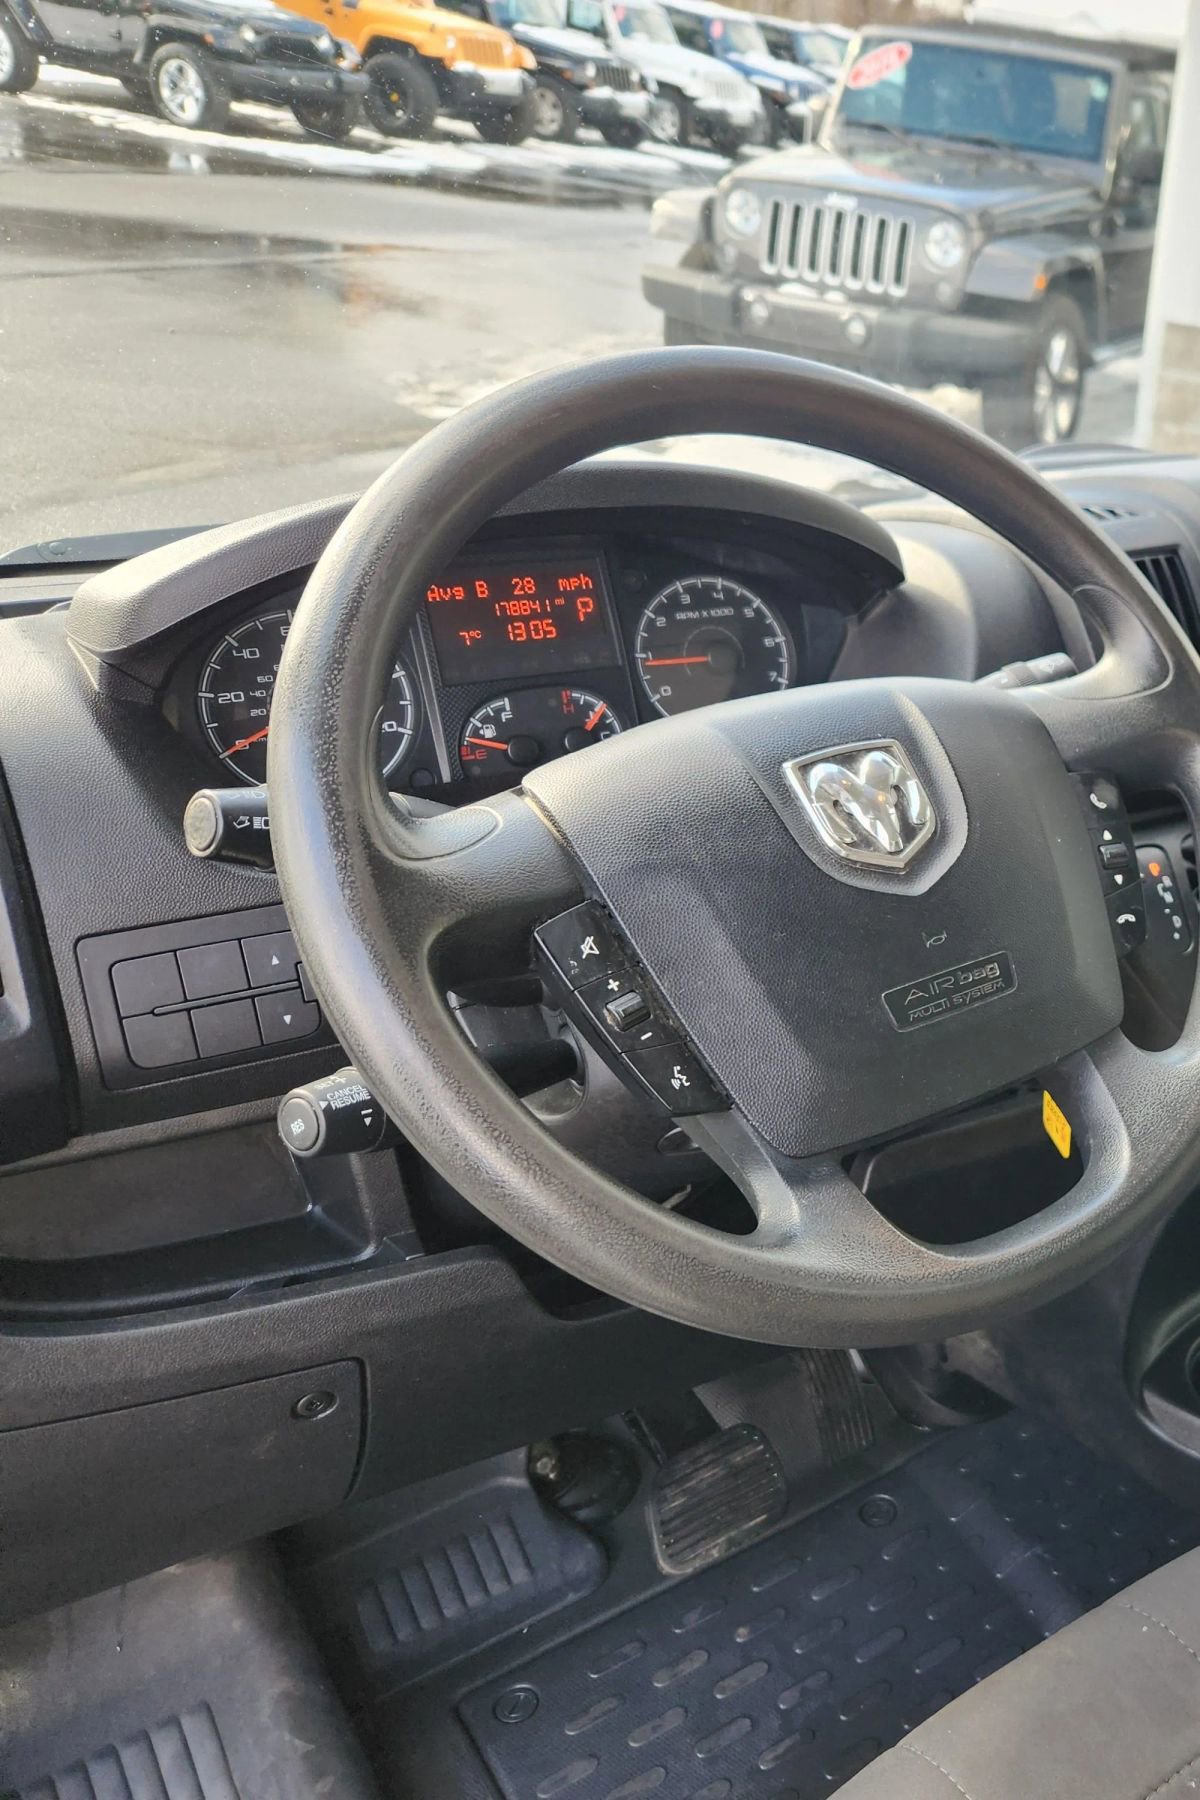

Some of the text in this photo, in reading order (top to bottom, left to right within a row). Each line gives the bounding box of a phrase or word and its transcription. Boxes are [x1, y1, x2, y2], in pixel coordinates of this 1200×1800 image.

[427, 573, 593, 602] Avg B 28 mph
[680, 593, 691, 604] 3
[712, 591, 724, 600] 4
[495, 599, 551, 617] 178841
[576, 596, 594, 622] P
[675, 611, 700, 620] RPM
[709, 607, 734, 617] 1000
[744, 607, 755, 618] 5
[656, 617, 667, 627] 2
[764, 637, 775, 648] 6
[232, 647, 260, 659] 40
[256, 674, 273, 683] 60
[769, 671, 778, 682] 7
[249, 689, 266, 697] 40
[660, 685, 672, 697] 0
[217, 691, 245, 704] 20
[249, 708, 267, 717] 20
[501, 711, 513, 722] F
[475, 749, 487, 760] E
[907, 978, 1005, 1022] MULTI SYSTEM
[326, 1084, 367, 1100] CANCEL
[330, 1091, 372, 1110] RESUME
[290, 1118, 305, 1136] RES
